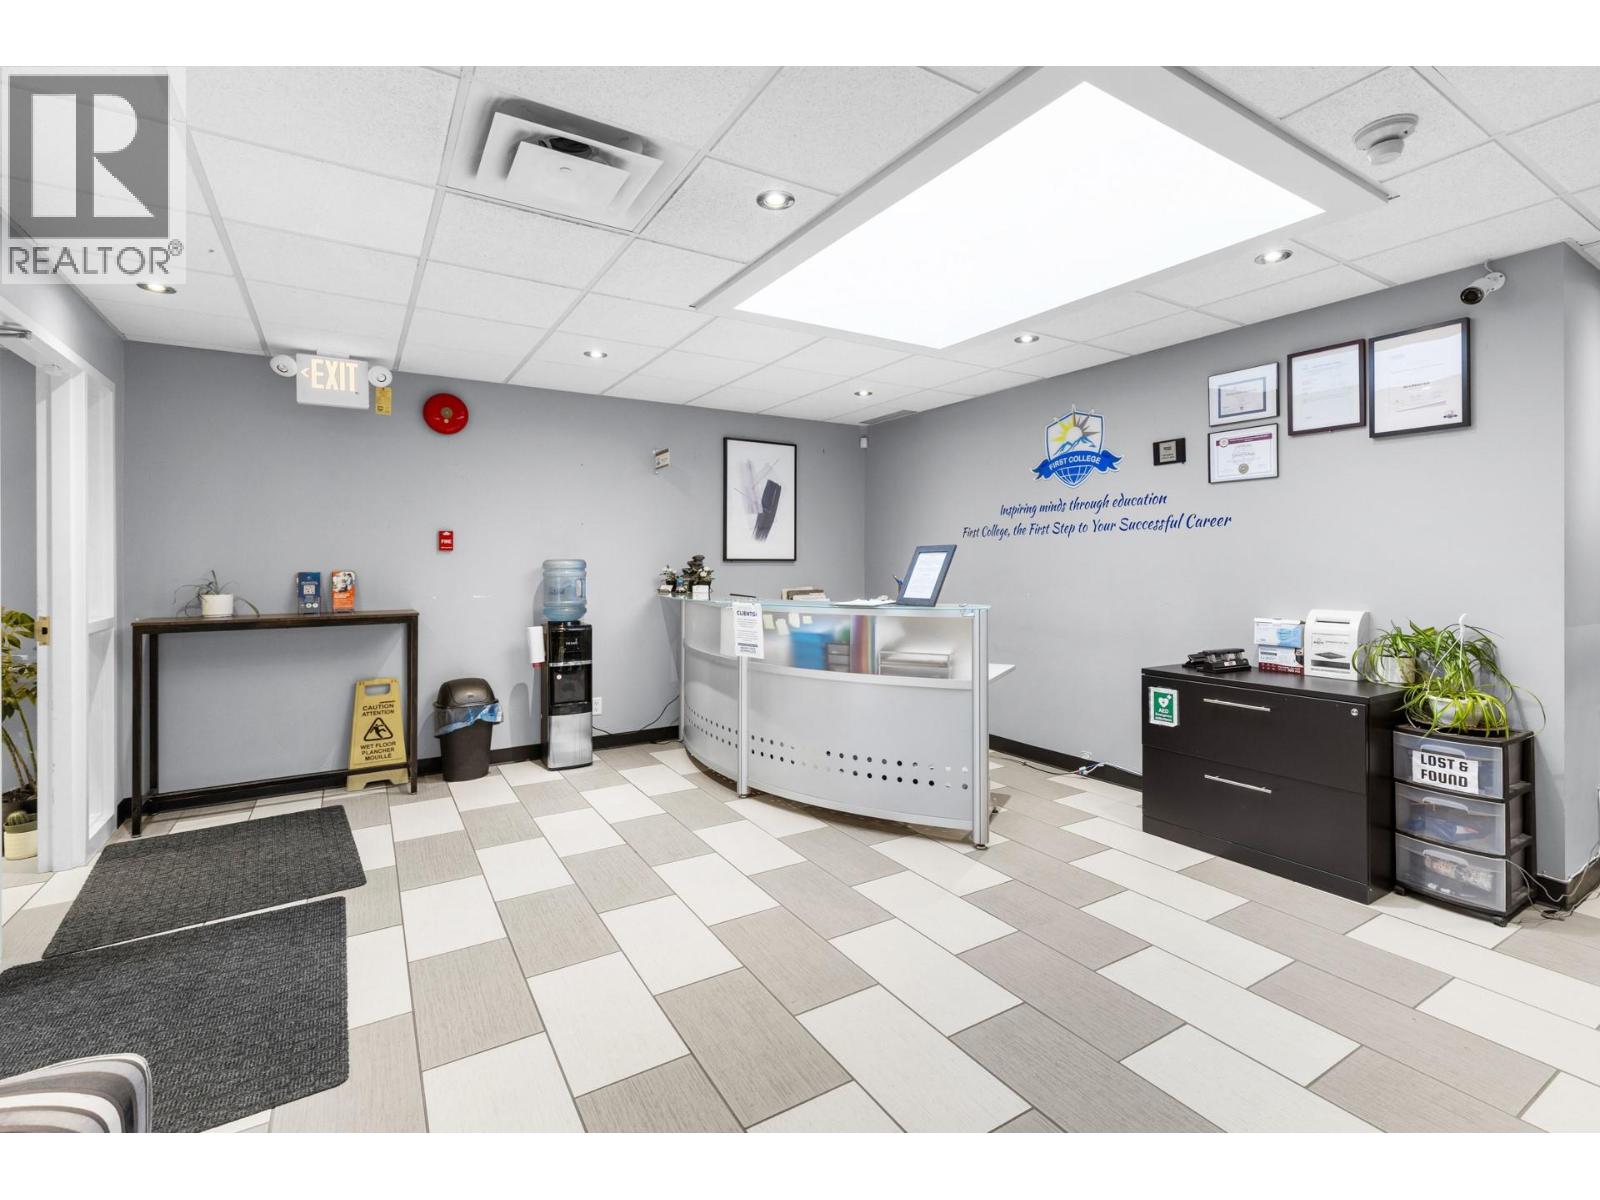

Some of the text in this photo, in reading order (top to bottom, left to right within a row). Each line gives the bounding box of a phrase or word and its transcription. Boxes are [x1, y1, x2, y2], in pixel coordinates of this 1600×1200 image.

[311, 358, 359, 393] EXIT
[1048, 454, 1102, 471] FIRST COLLEGE
[1000, 492, 1168, 519] Inspiring minds through education
[962, 512, 1232, 541] First College, the First Step to Your Successful Career
[362, 703, 395, 711] CAUTION
[362, 709, 395, 717] ATTENTION
[360, 743, 374, 751] WET
[361, 747, 395, 756] PLANCHER
[1420, 753, 1469, 773] LOST &
[1420, 768, 1468, 788] FOUND
